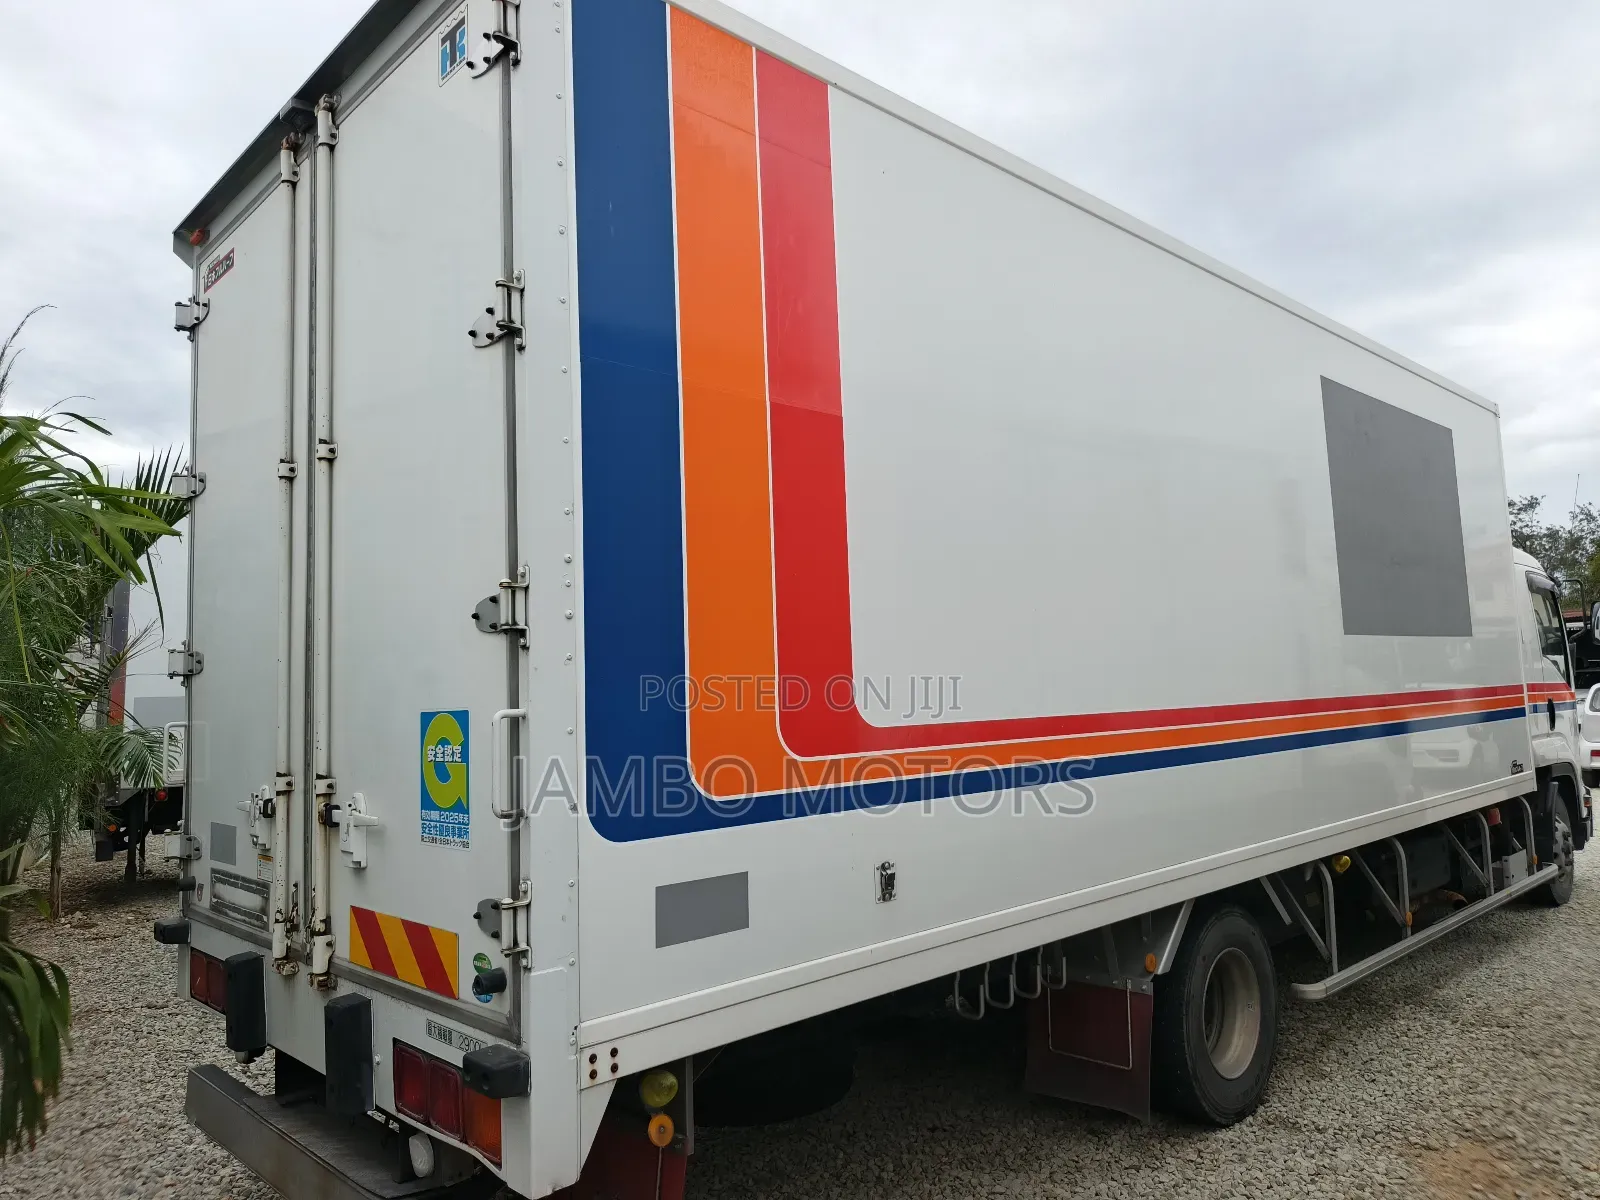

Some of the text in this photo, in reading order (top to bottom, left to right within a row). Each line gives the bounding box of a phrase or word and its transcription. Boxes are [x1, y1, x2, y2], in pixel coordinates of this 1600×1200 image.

[427, 744, 462, 763] 安全認定
[421, 822, 470, 840] 安全性優良事業所
